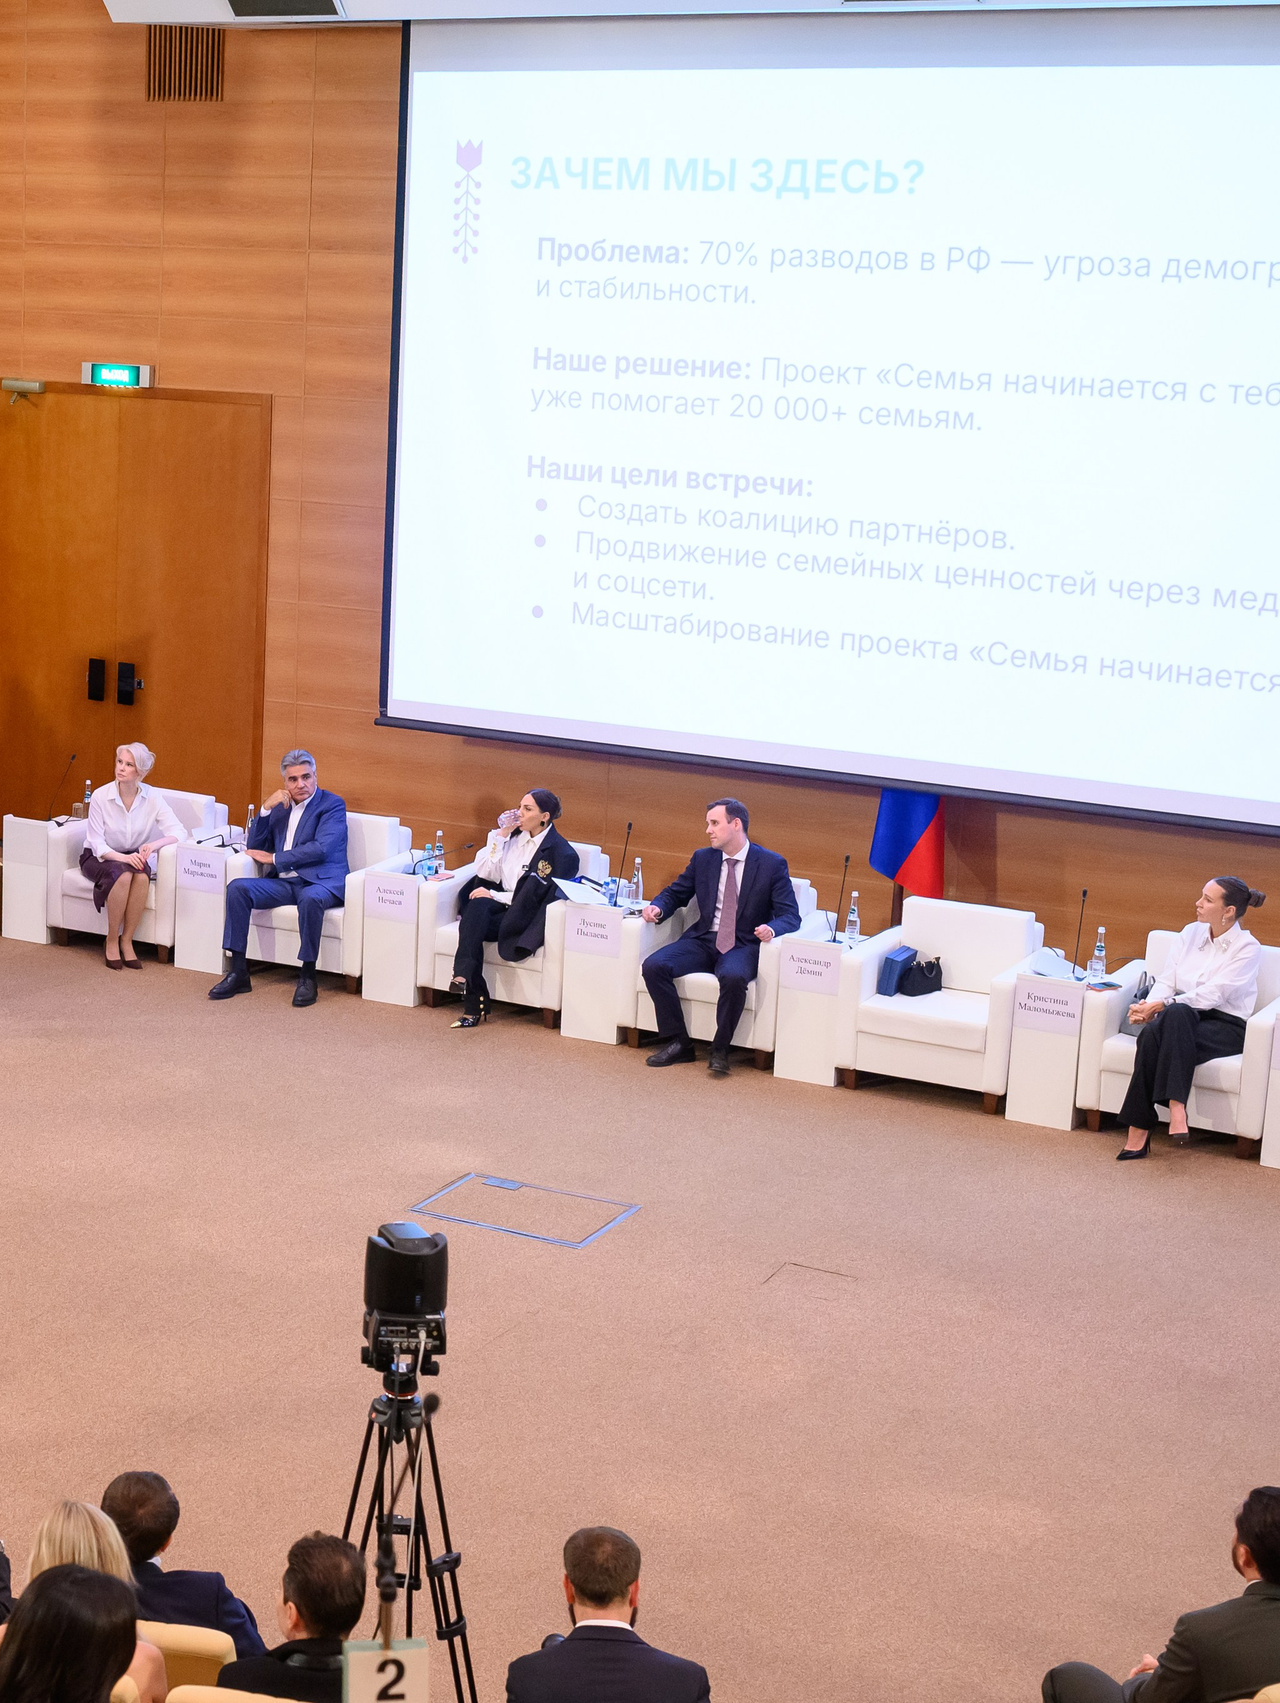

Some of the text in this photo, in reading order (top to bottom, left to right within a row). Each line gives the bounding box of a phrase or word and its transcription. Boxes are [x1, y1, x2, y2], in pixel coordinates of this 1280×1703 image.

[509, 155, 925, 201] ЗАЧЕМ МЫ ЗДЕСЬ?
[537, 236, 690, 268] Проблема:
[699, 240, 758, 267] 70%
[769, 247, 909, 275] разводов
[919, 251, 936, 272] в
[946, 245, 991, 275] РФ
[1043, 254, 1152, 283] угроза
[536, 275, 756, 305] и стабильности.
[101, 368, 129, 383] ВЫХОД
[532, 346, 1280, 407] Наше решение: Проект «Семья начинается с теб
[530, 388, 982, 432] уже помогает 20 000+ семьям.
[527, 454, 813, 499] Наши цели встречи:
[577, 494, 1015, 553] Создать коалицию партнёров.
[573, 570, 715, 601] и соцсети.
[575, 530, 1279, 618] Продвижение семейных ценностей через мед
[572, 601, 1280, 693] Масштабирование проекта «Семья начинается
[190, 859, 211, 868] Мария
[376, 886, 405, 896] Алексей
[378, 896, 403, 906] Нечаев
[576, 928, 609, 940] Пылаева
[579, 918, 607, 930] Лусине
[789, 954, 832, 969] Александр
[795, 965, 823, 977] Дёмин
[1018, 1002, 1076, 1019] Маломыжева
[1027, 992, 1069, 1006] Кристина
[376, 1658, 405, 1701] 2
